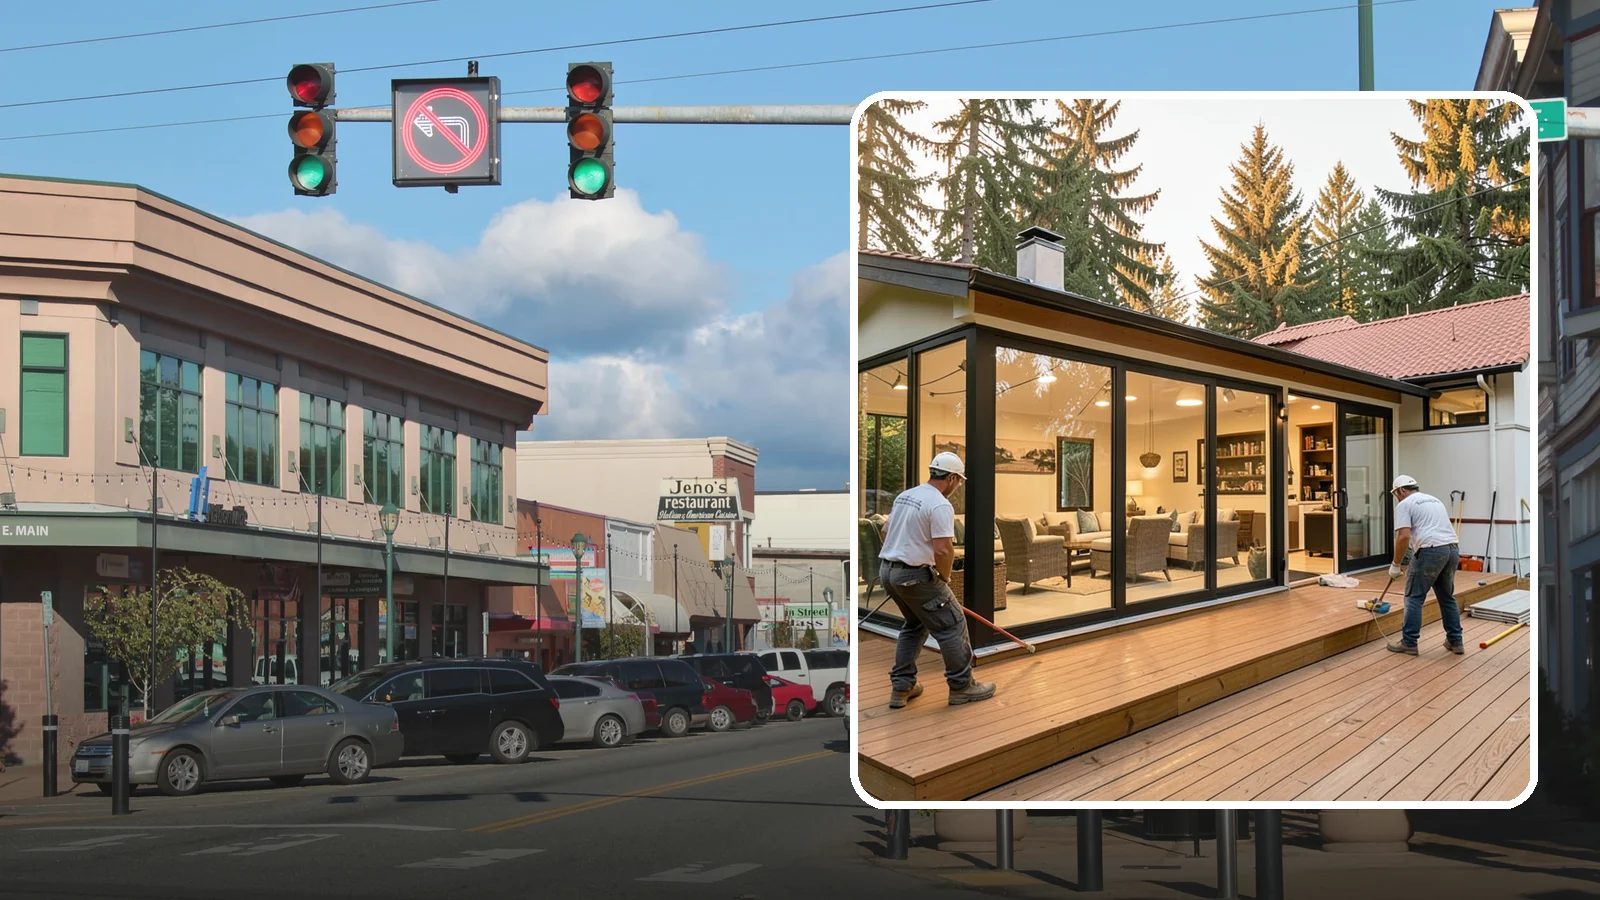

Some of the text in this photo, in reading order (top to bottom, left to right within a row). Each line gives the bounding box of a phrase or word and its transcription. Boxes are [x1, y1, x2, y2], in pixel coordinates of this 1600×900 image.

[669, 480, 728, 494] Jeno's
[665, 496, 731, 509] restaurant
[658, 509, 682, 519] Italian
[686, 509, 715, 519] American
[715, 509, 738, 519] Cuisine
[2, 525, 49, 536] E. MAIN
[797, 607, 828, 617] Street
